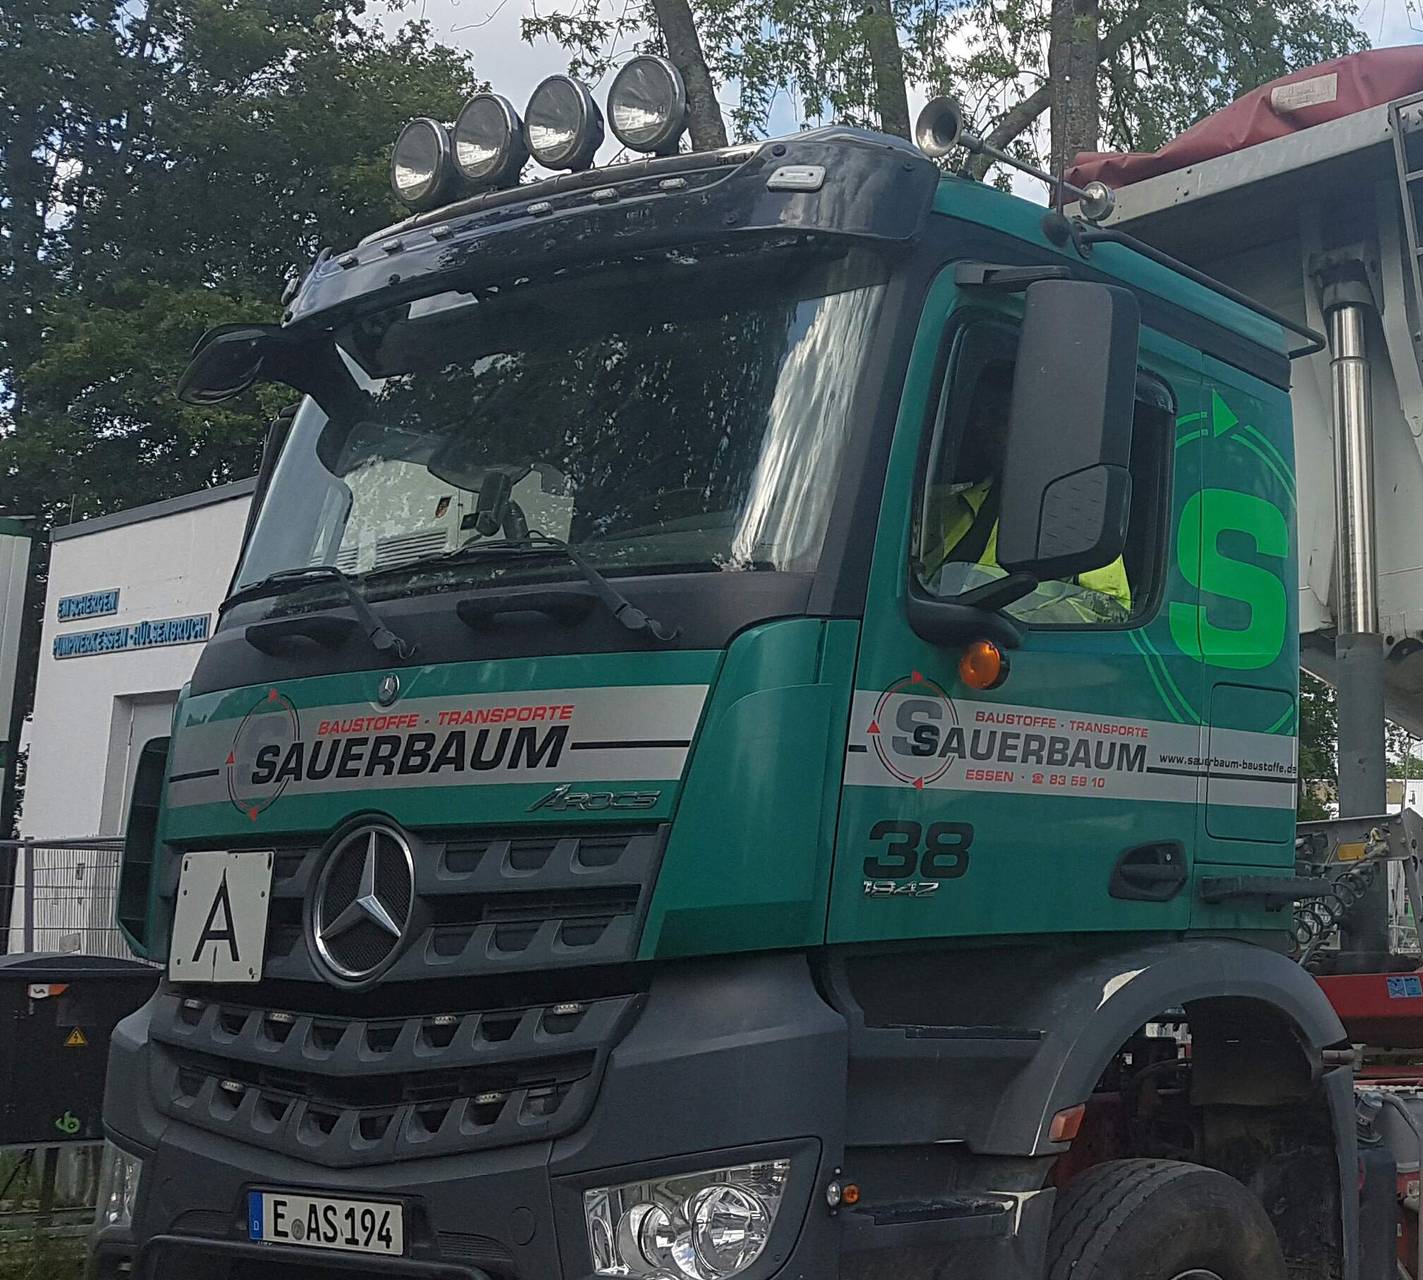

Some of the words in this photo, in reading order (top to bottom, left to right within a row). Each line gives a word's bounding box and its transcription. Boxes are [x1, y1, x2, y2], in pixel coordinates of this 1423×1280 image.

[1169, 488, 1289, 671] S
[318, 714, 418, 735] BAUSTOFFE
[438, 704, 575, 726] TRANSPORTE
[975, 711, 1056, 728] BAUSTOFFE
[1070, 720, 1149, 738] TRANSPORTE
[251, 725, 569, 785] SAUERBAUM
[911, 724, 1147, 773] SAUERBAUM
[1159, 754, 1297, 774] www.sauerbaum-baustoffe.de
[965, 769, 1014, 782] ESSEN
[1050, 774, 1067, 785] 83
[1091, 777, 1105, 788] 10
[863, 820, 974, 878] 38
[192, 867, 240, 962] A
[273, 1200, 289, 1238] E
[306, 1203, 339, 1243] AS
[344, 1207, 392, 1249] 194
